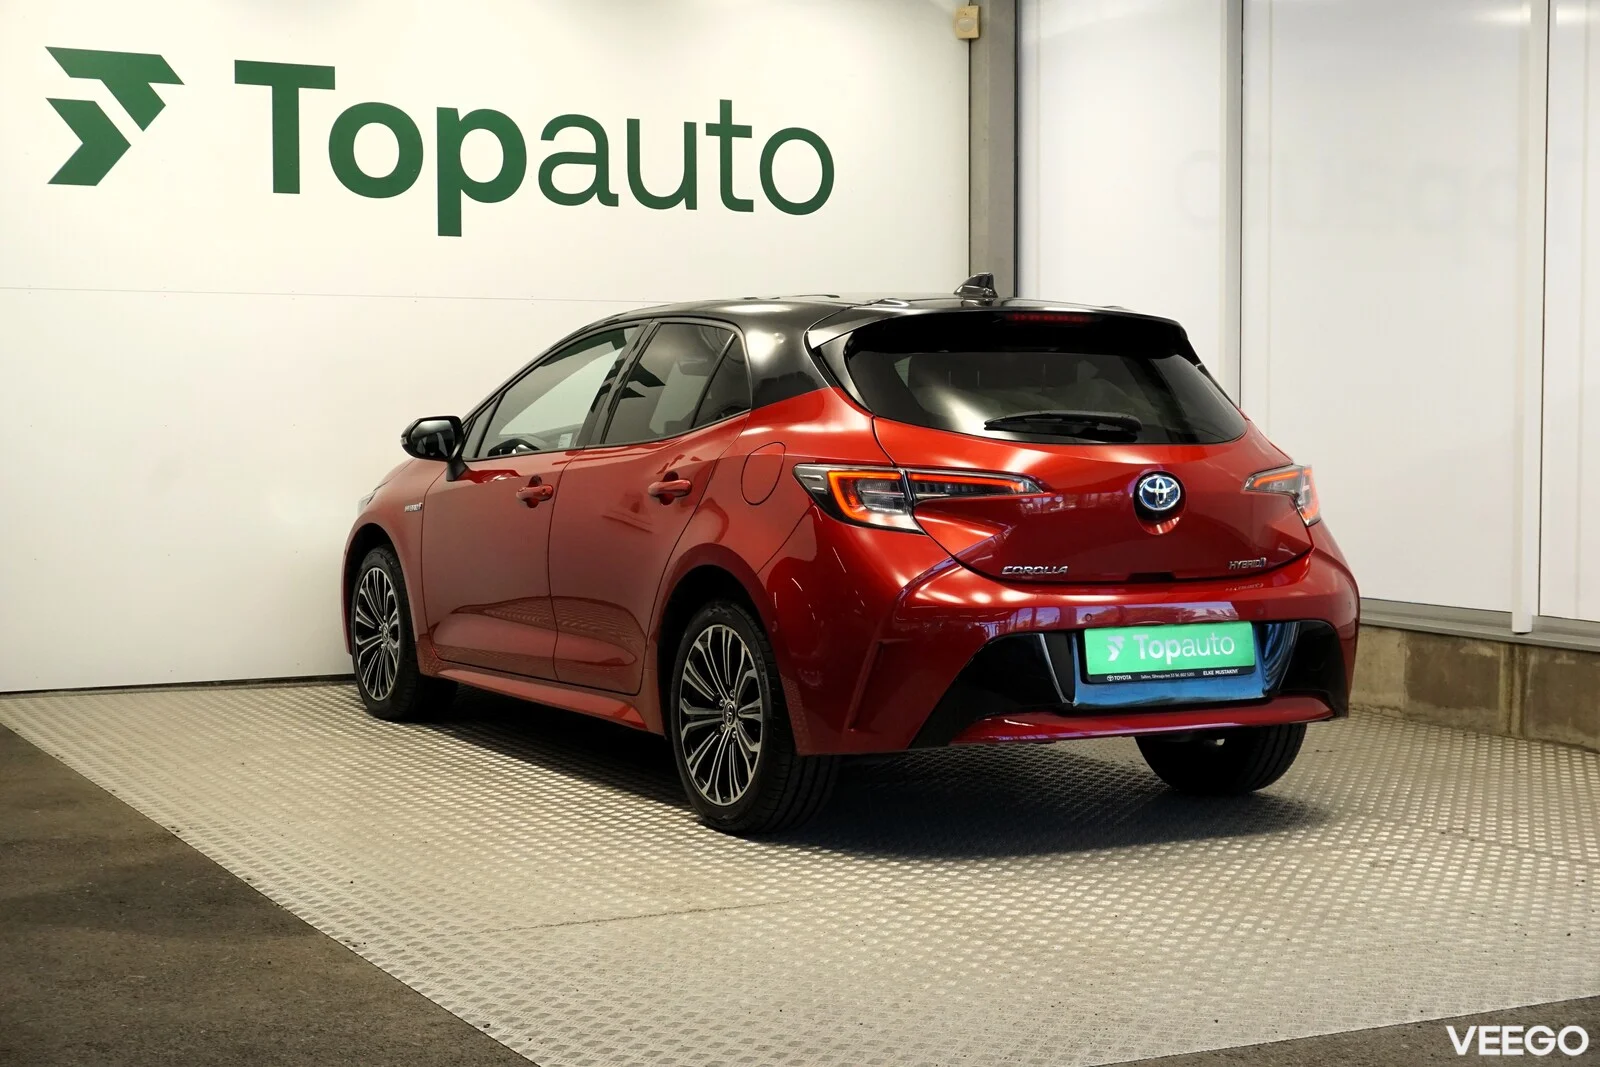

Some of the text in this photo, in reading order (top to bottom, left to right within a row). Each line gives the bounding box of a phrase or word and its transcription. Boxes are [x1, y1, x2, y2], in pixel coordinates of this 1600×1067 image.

[234, 59, 835, 237] Topauto
[1001, 565, 1069, 575] COROLLA
[1228, 559, 1262, 569] HYBRID
[1133, 632, 1235, 664] Topauto
